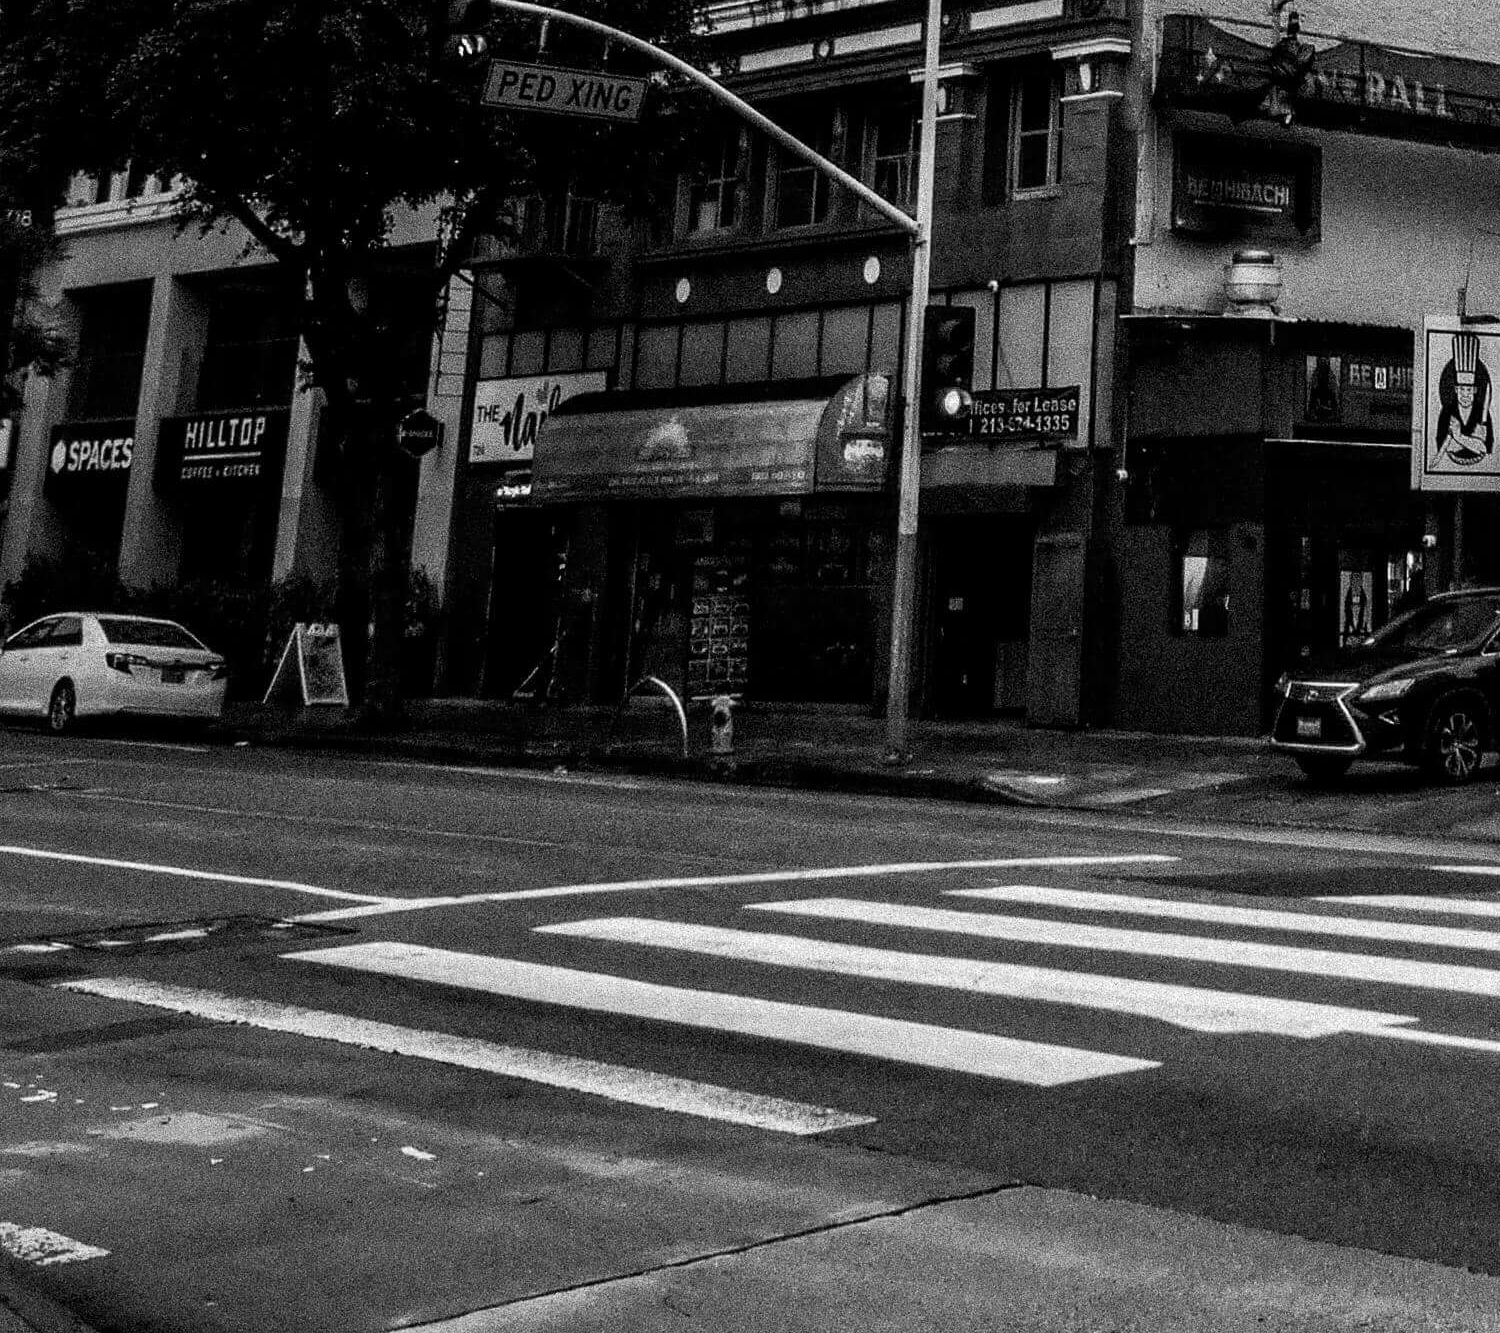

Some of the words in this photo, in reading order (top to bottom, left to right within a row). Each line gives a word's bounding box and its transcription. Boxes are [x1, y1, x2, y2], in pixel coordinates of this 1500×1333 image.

[499, 70, 556, 102] PED
[566, 79, 632, 112] XING
[477, 405, 499, 423] THE
[969, 398, 1006, 416] ffices
[1033, 396, 1077, 414] Lease
[184, 416, 267, 449] HILLTOP
[67, 437, 134, 472] SPACES
[181, 465, 214, 480] COFFEE
[222, 463, 261, 478] KITCHEN
